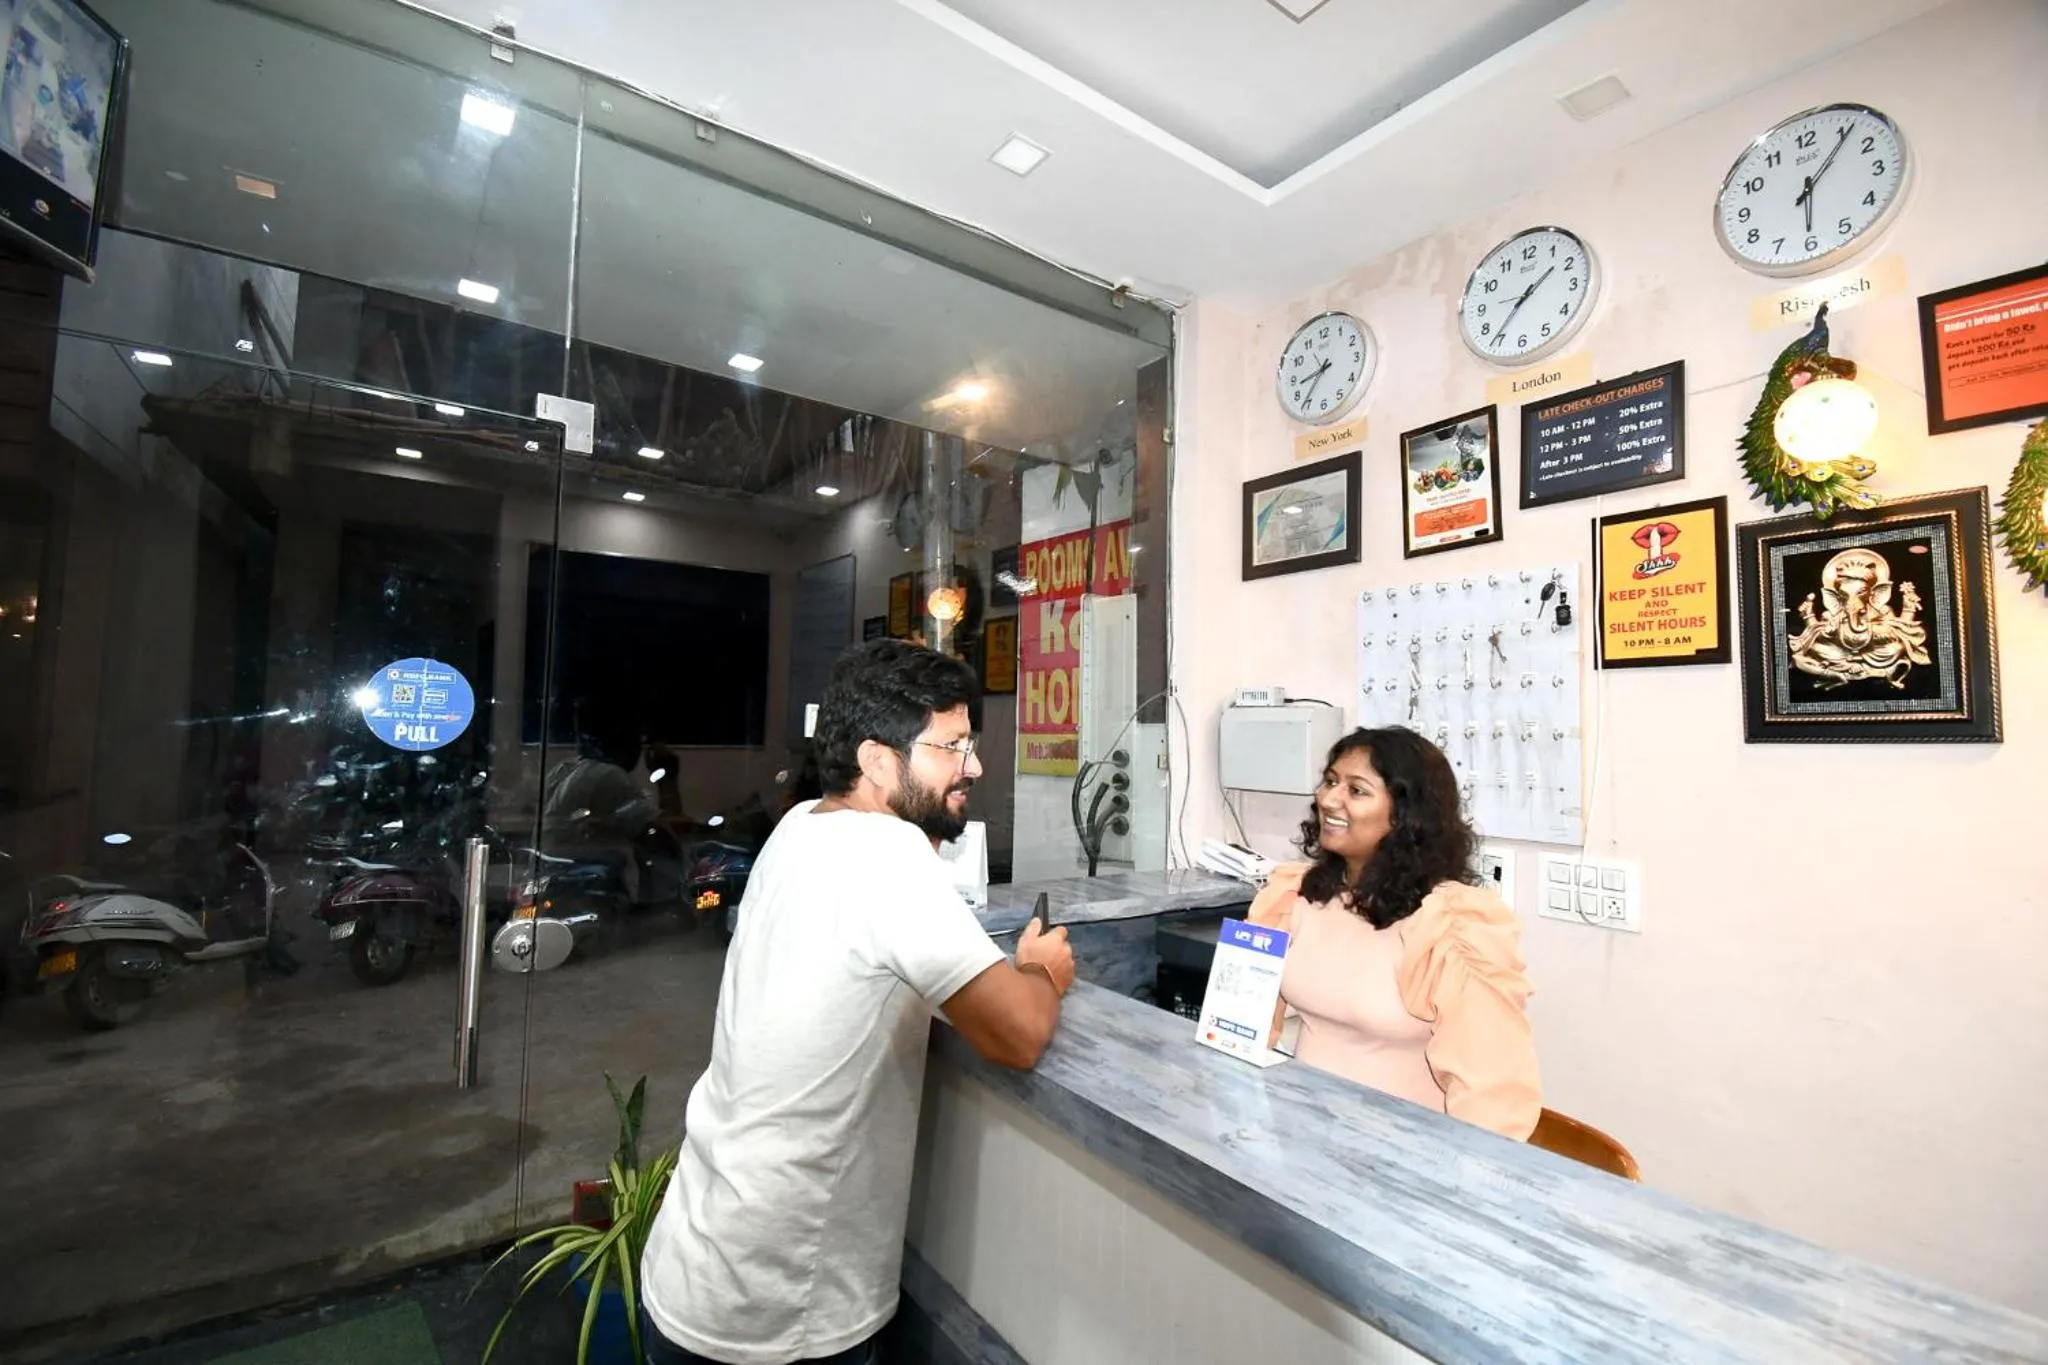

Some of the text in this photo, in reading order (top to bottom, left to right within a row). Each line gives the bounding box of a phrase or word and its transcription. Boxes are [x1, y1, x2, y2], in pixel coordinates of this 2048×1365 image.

[1795, 131, 1816, 149] 12
[1861, 136, 1875, 154] 2
[1765, 151, 1781, 168] 11
[1872, 160, 1885, 176] 3
[1742, 177, 1764, 195] 10
[1863, 191, 1876, 206] 4
[1738, 207, 1750, 223] 9
[1839, 218, 1852, 234] 5
[1747, 229, 1760, 244] 8
[1772, 238, 1784, 255] 7
[1804, 236, 1817, 252] 6
[1522, 245, 1537, 260] 12
[1549, 245, 1556, 258] 1
[1500, 259, 1512, 273] 11
[1564, 256, 1574, 271] 2
[1483, 279, 1498, 294] 10
[1569, 277, 1578, 291] 3
[1477, 303, 1487, 317] 9
[1559, 302, 1569, 316] 4
[1320, 327, 1330, 339] 12
[1338, 326, 1343, 336] 1
[1481, 323, 1490, 335] 8
[1541, 323, 1551, 337] 5
[1304, 339, 1312, 350] 11
[1349, 335, 1356, 347] 2
[1498, 333, 1506, 347] 7
[1517, 334, 1527, 348] 6
[1294, 355, 1304, 367] 10
[1354, 351, 1360, 363] 3
[1291, 375, 1297, 386] 9
[1348, 372, 1354, 382] 4
[1512, 371, 1562, 392] London
[1294, 390, 1300, 401] 8
[1336, 389, 1343, 400] 5
[1538, 377, 1665, 421] LATE CHECK-OUT CHARGES
[1305, 399, 1312, 409] 7
[1320, 399, 1327, 410] 6
[1541, 429, 1550, 438] 10
[1551, 424, 1565, 435] AM
[1571, 420, 1582, 430] 12
[1582, 417, 1596, 427] PM
[1619, 407, 1637, 418] 20%
[1639, 400, 1664, 413] Extra
[1308, 428, 1352, 449] New York
[1540, 444, 1549, 453] 12
[1551, 441, 1563, 451] PM
[1571, 438, 1577, 447] 3
[1578, 434, 1592, 445] PM
[1619, 424, 1638, 435] 50%
[1639, 417, 1663, 430] Extra
[1540, 458, 1560, 470] After
[1563, 455, 1569, 465] 3
[1570, 453, 1583, 462] PM
[1616, 441, 1640, 452] 100%
[1642, 434, 1666, 446] Extra
[1609, 582, 1707, 602] KEEP SILENT
[1645, 600, 1668, 608] AND
[1638, 608, 1677, 617] RESPECT
[1609, 616, 1707, 634] SILENT HOURS
[1638, 638, 1655, 646] PM
[1674, 636, 1692, 644] AM
[394, 723, 439, 742] PULL
